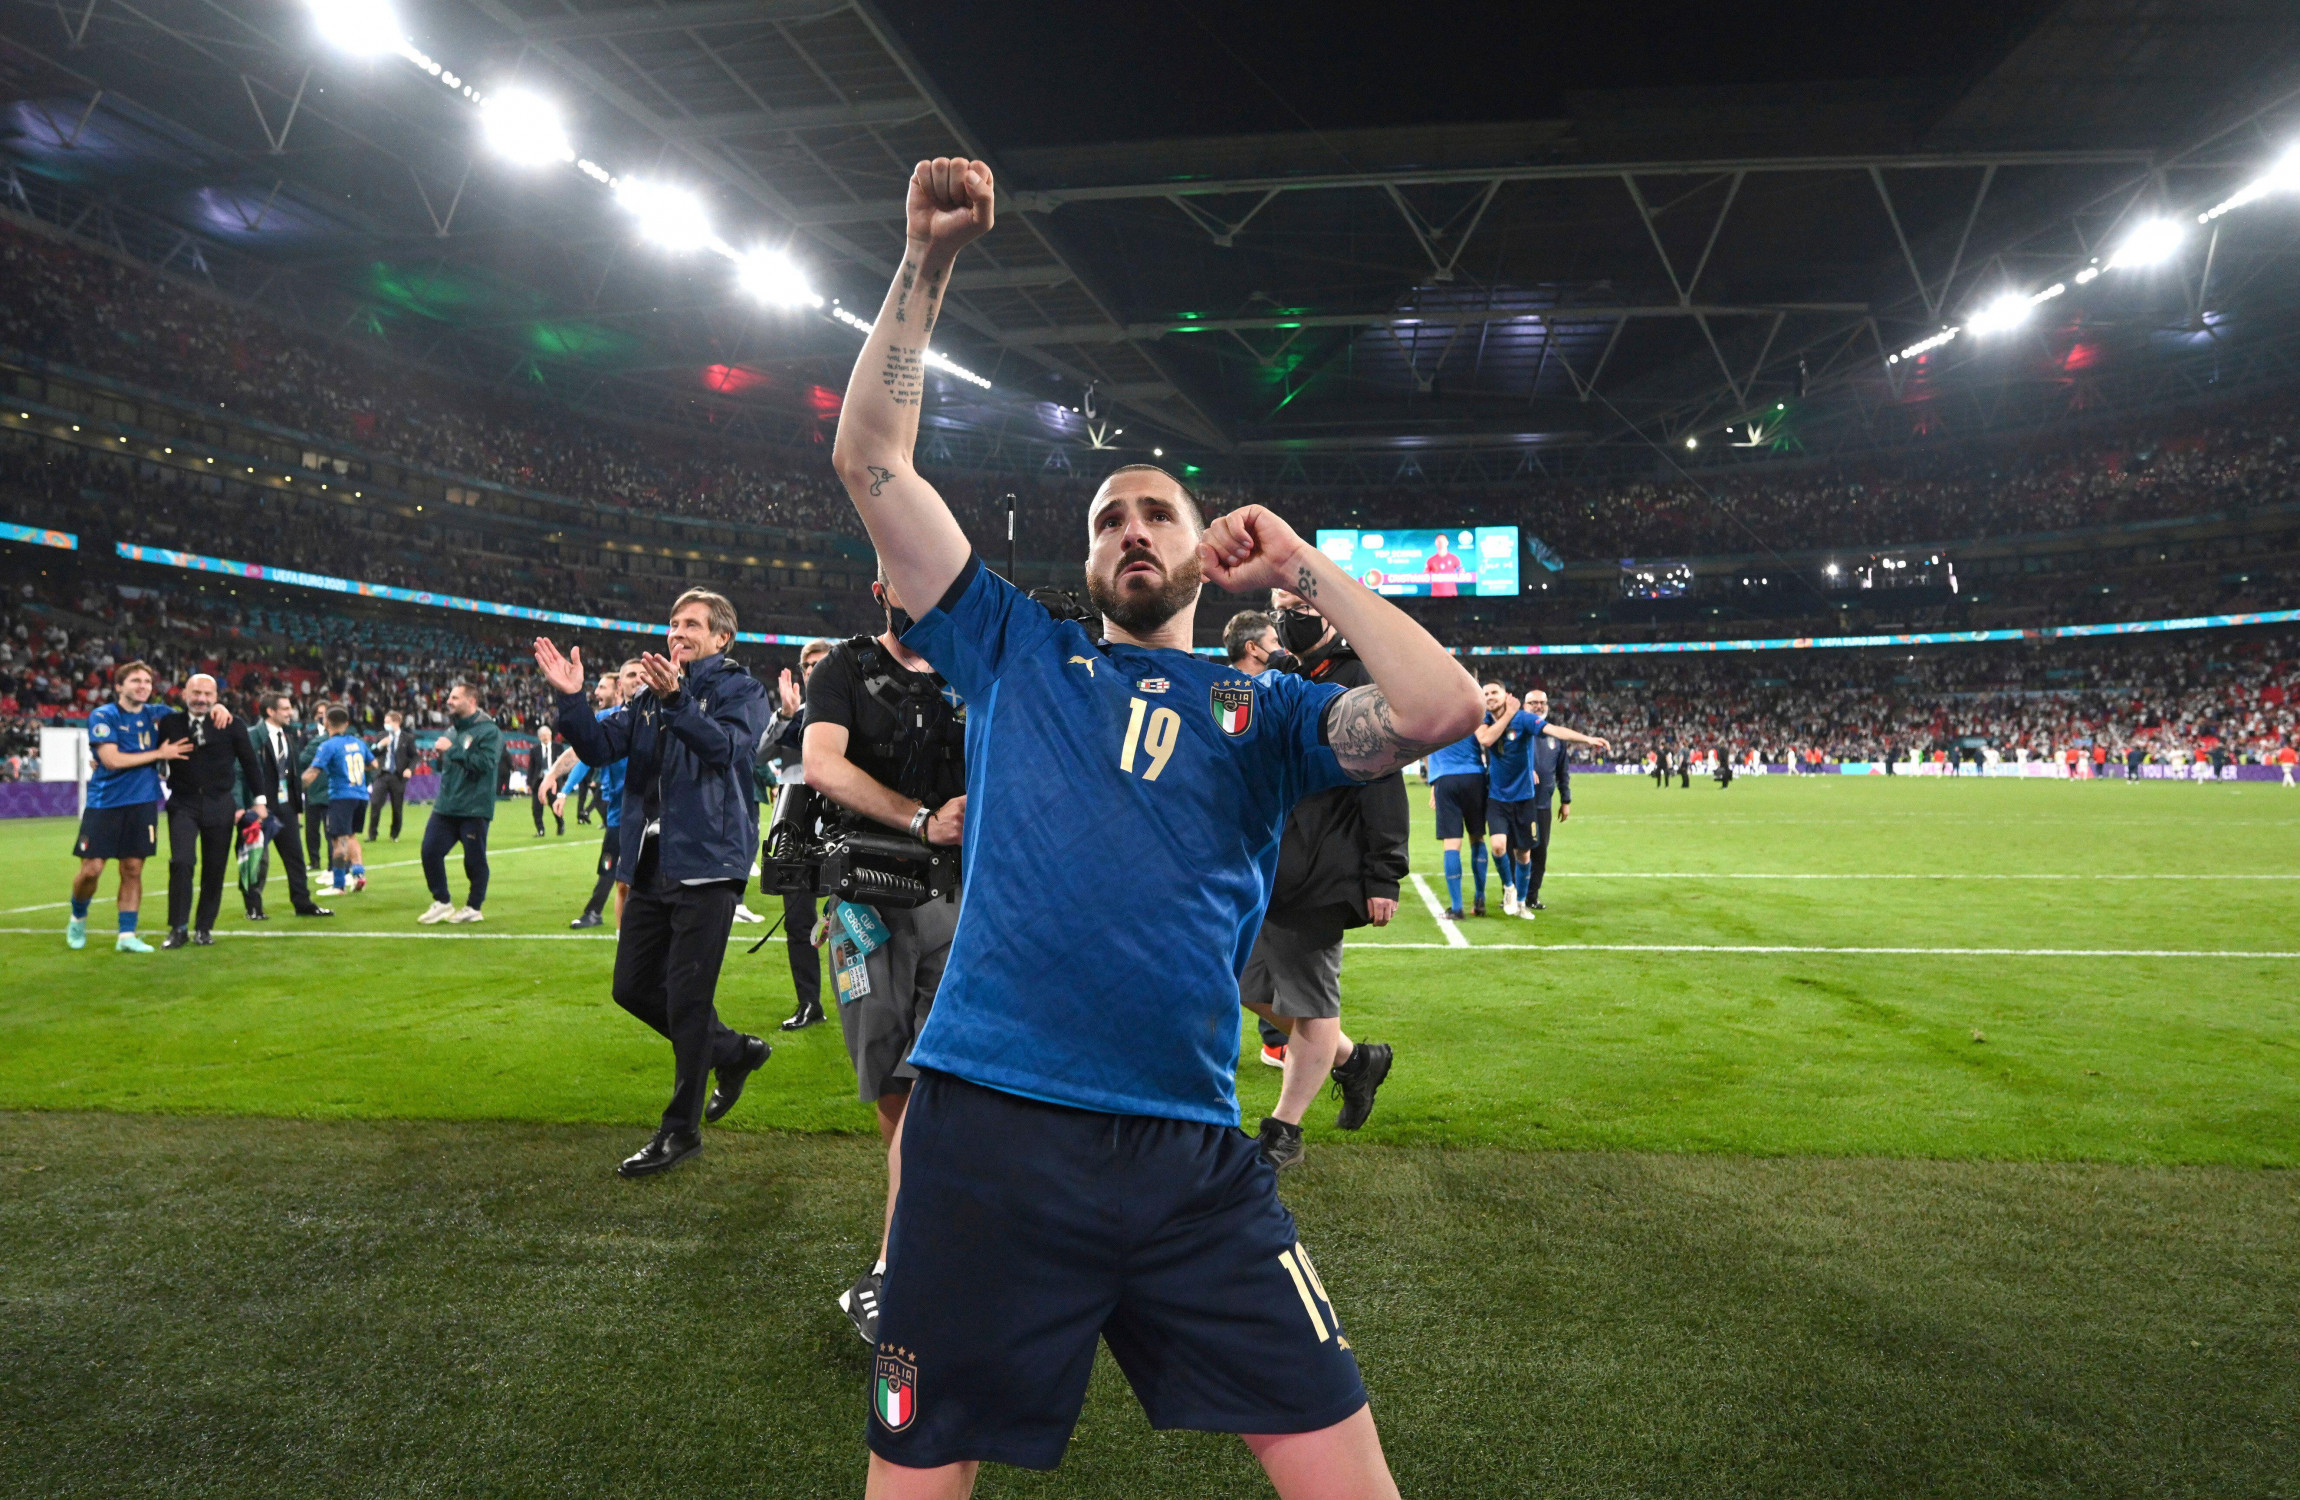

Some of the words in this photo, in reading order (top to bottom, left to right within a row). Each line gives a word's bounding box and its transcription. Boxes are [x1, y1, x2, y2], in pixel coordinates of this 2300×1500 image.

[272, 568, 298, 584] UEFA
[298, 572, 324, 588] EURO
[2163, 617, 2208, 630] LONDON
[1819, 637, 1843, 648] UEFA
[1843, 636, 1867, 647] EURO
[1213, 690, 1249, 702] ITALIA
[1120, 697, 1181, 781] 19
[345, 752, 365, 786] 10
[844, 907, 878, 952] CEREMONY
[860, 913, 876, 930] CUP
[879, 1360, 913, 1382] ITALIA
